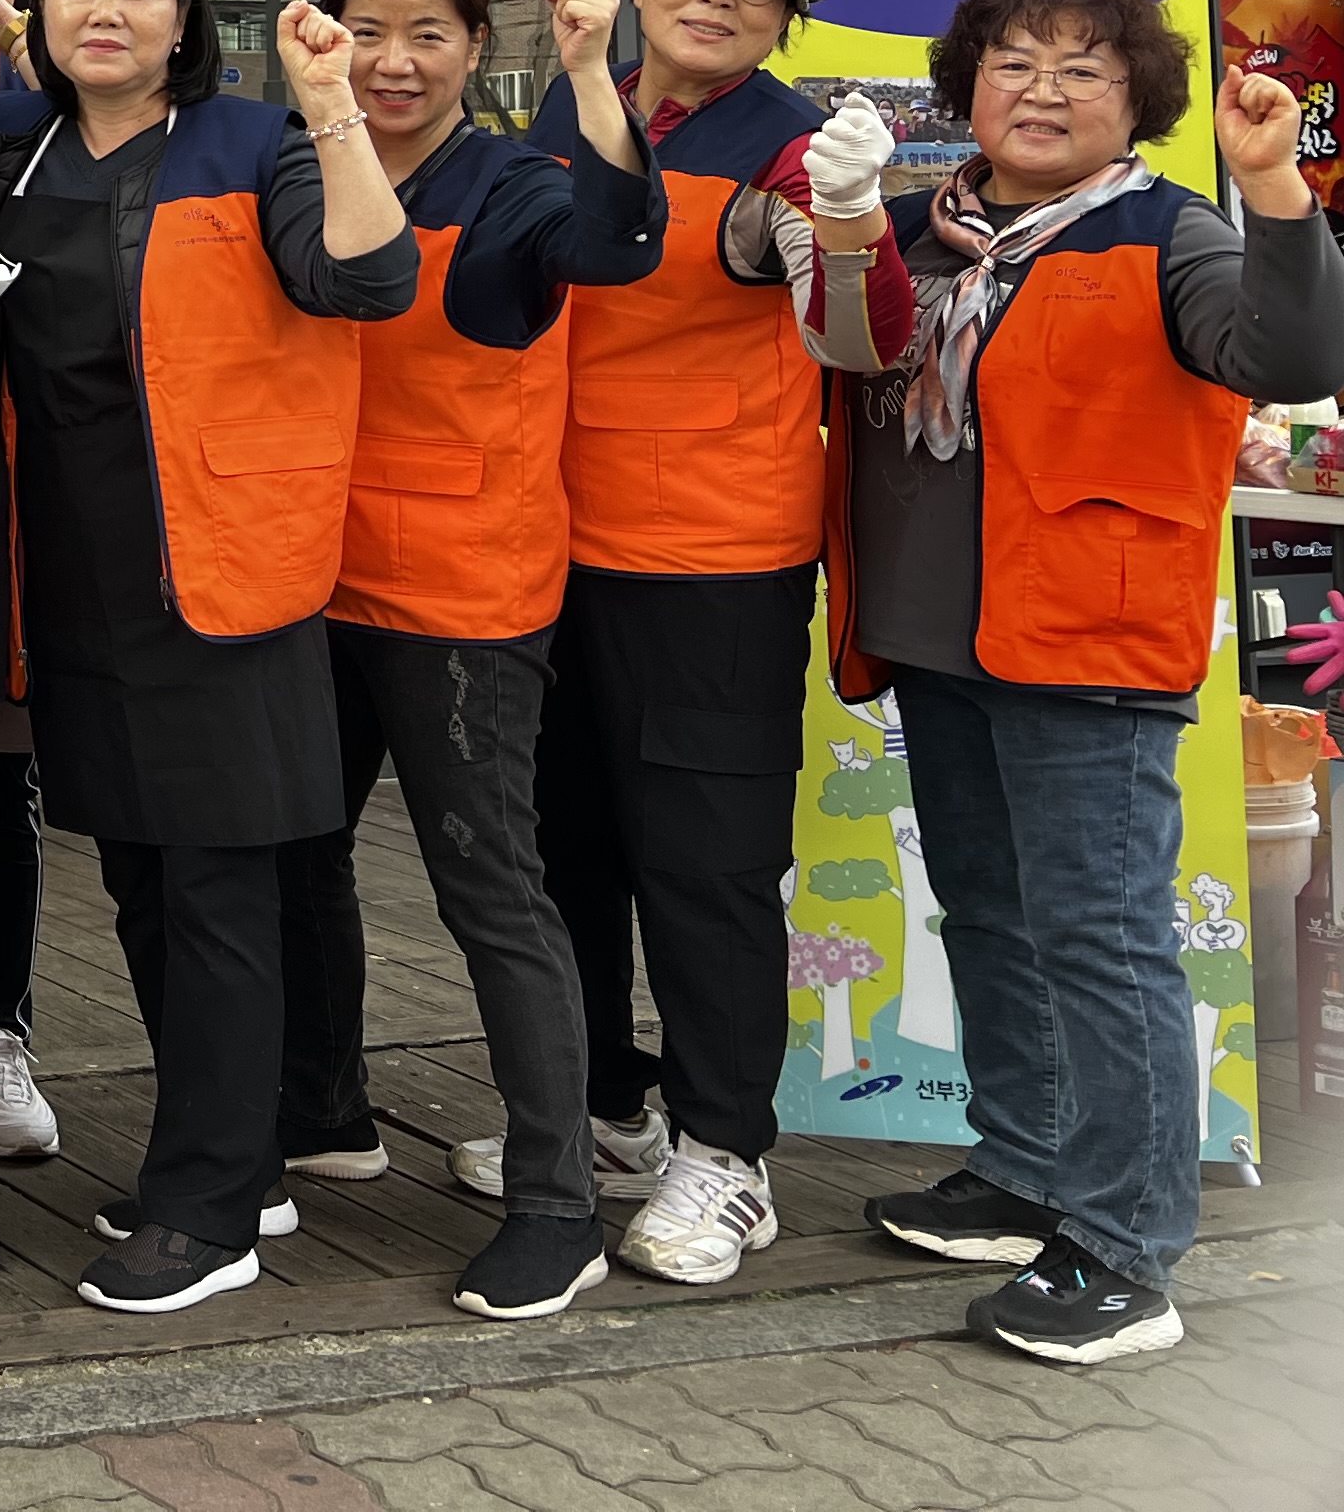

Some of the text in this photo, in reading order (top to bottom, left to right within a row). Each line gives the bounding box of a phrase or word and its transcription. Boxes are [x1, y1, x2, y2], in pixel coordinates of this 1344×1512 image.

[1246, 49, 1278, 69] NEW
[1296, 123, 1337, 162] 치즈
[908, 151, 952, 168] 함께하는
[914, 1078, 973, 1103] 선부3
